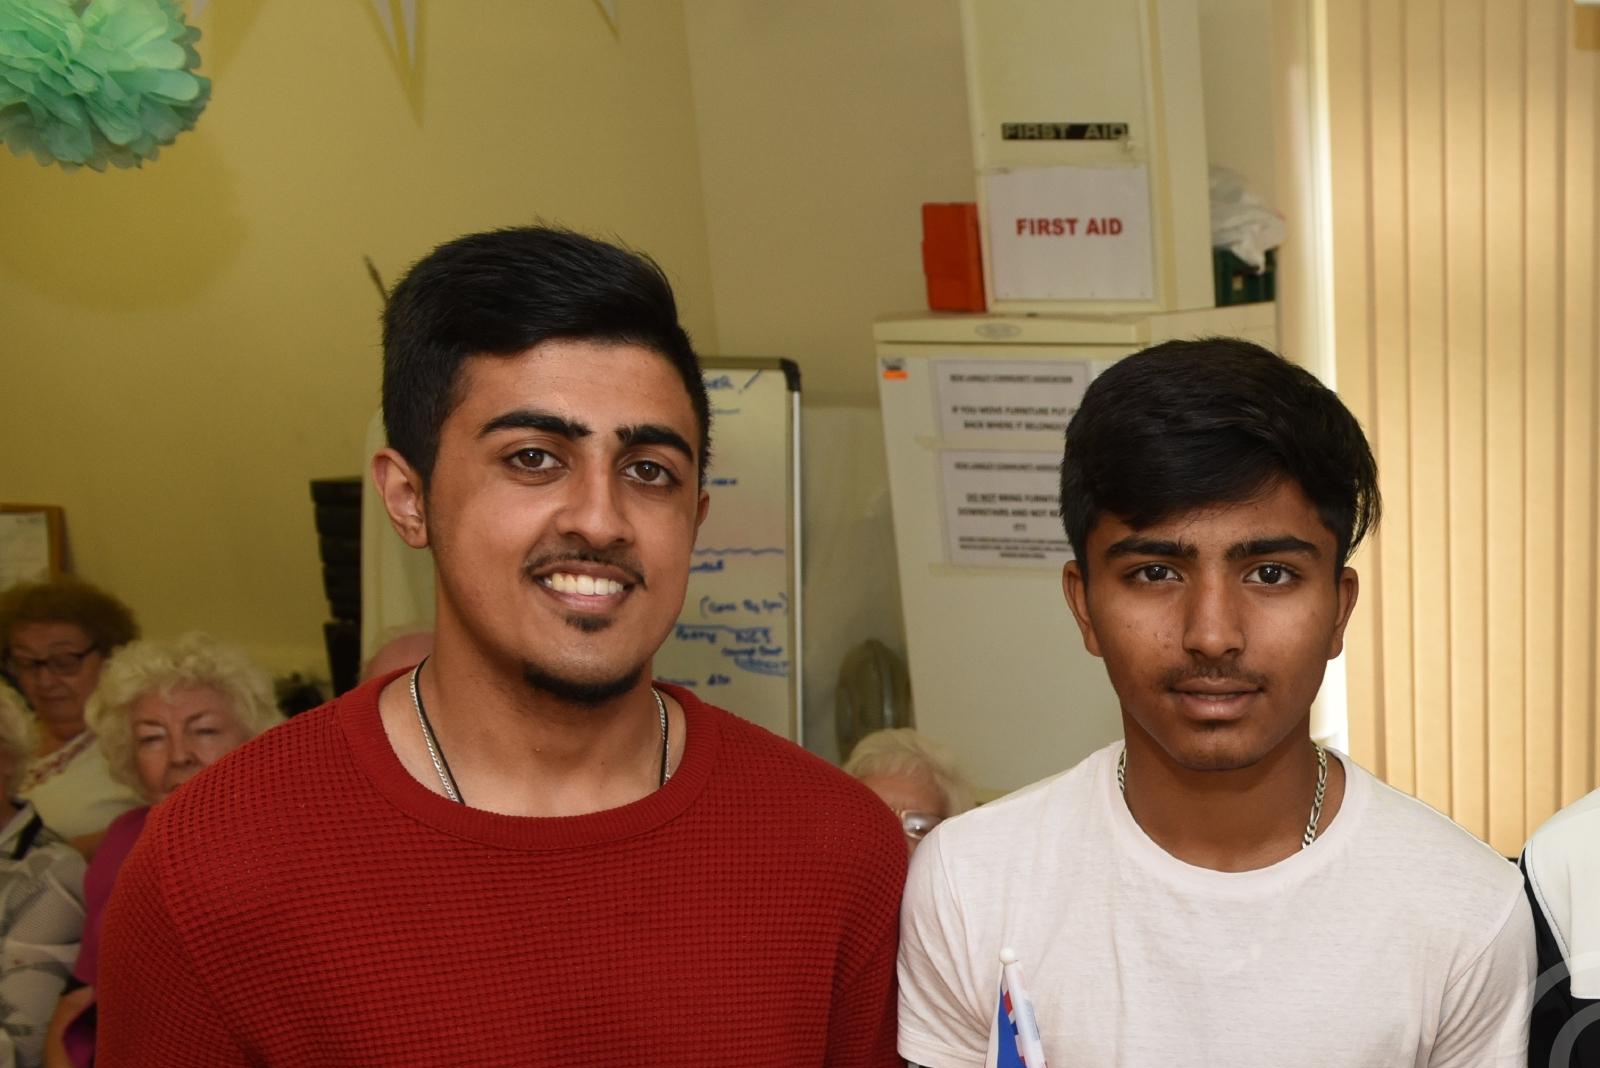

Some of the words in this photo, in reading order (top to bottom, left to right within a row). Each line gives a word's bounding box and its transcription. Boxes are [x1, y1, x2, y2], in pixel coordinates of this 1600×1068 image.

[1004, 123, 1069, 140] FIRST
[1084, 123, 1127, 140] AID
[1015, 217, 1078, 236] FIRST
[1085, 217, 1123, 236] AID
